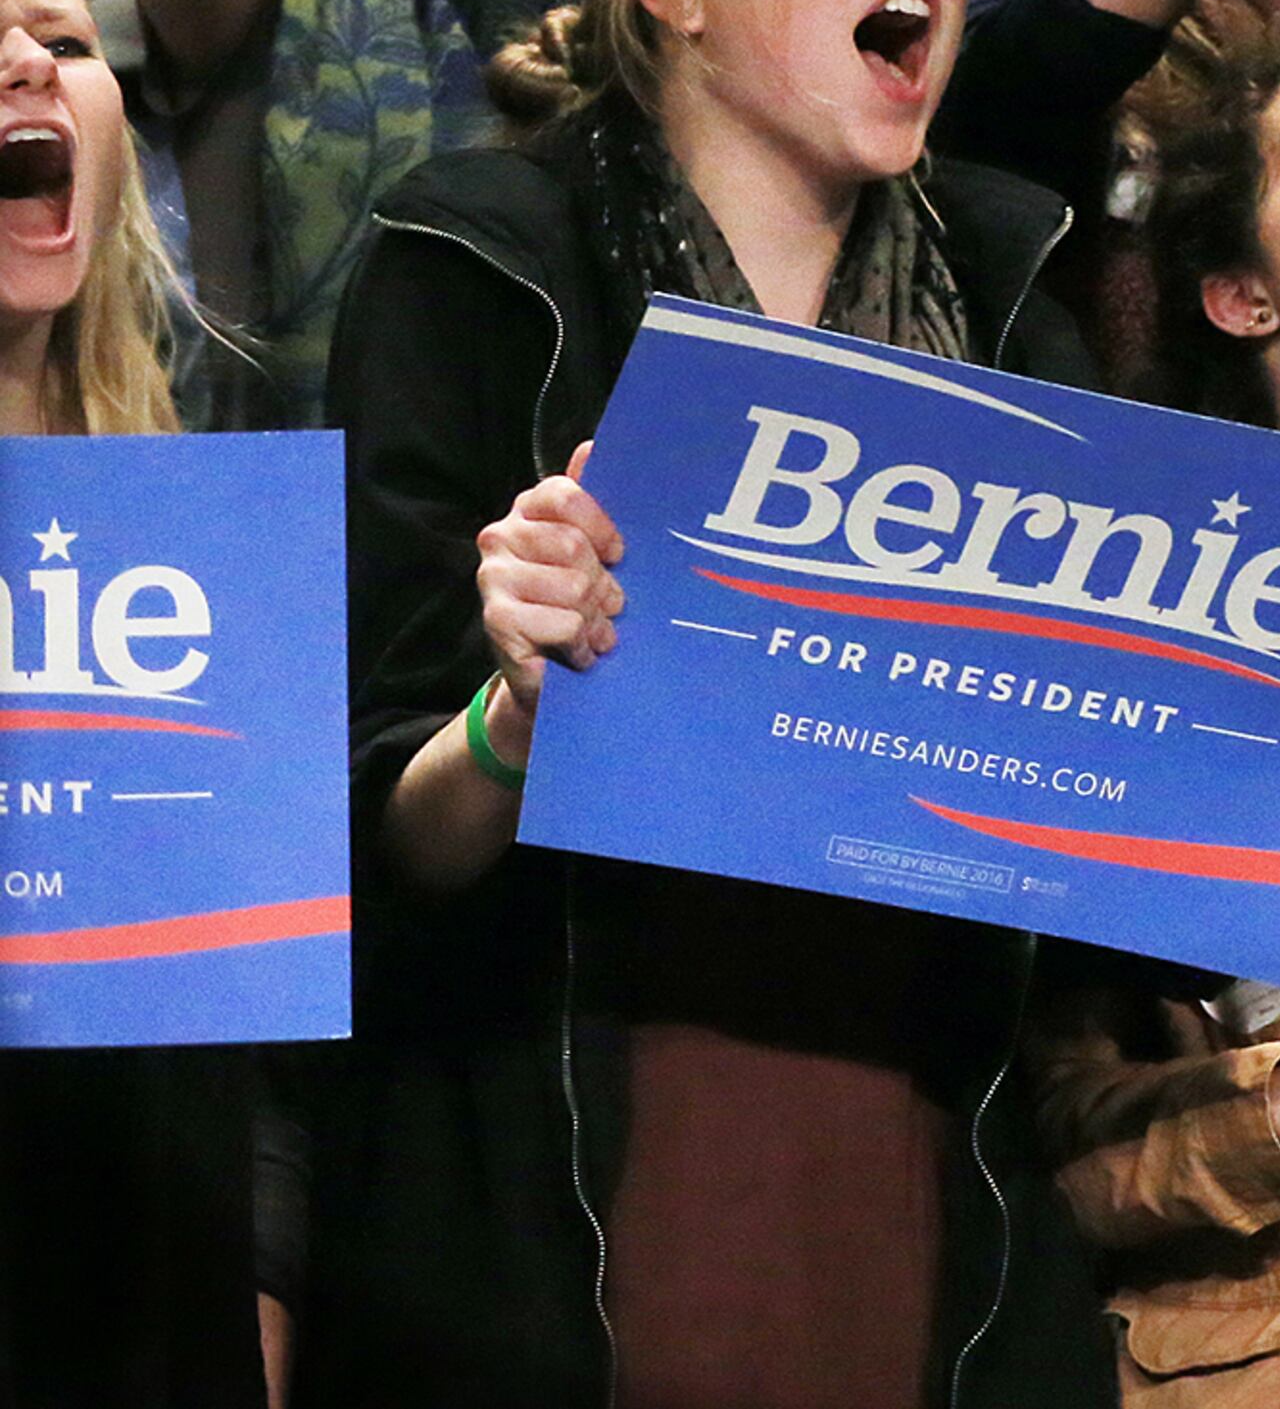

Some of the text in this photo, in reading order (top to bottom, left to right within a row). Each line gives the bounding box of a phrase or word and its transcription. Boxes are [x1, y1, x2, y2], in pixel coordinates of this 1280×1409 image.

[766, 628, 1182, 735] FOR PRESIDENT
[770, 712, 1128, 804] BERNIESANDERS.COM
